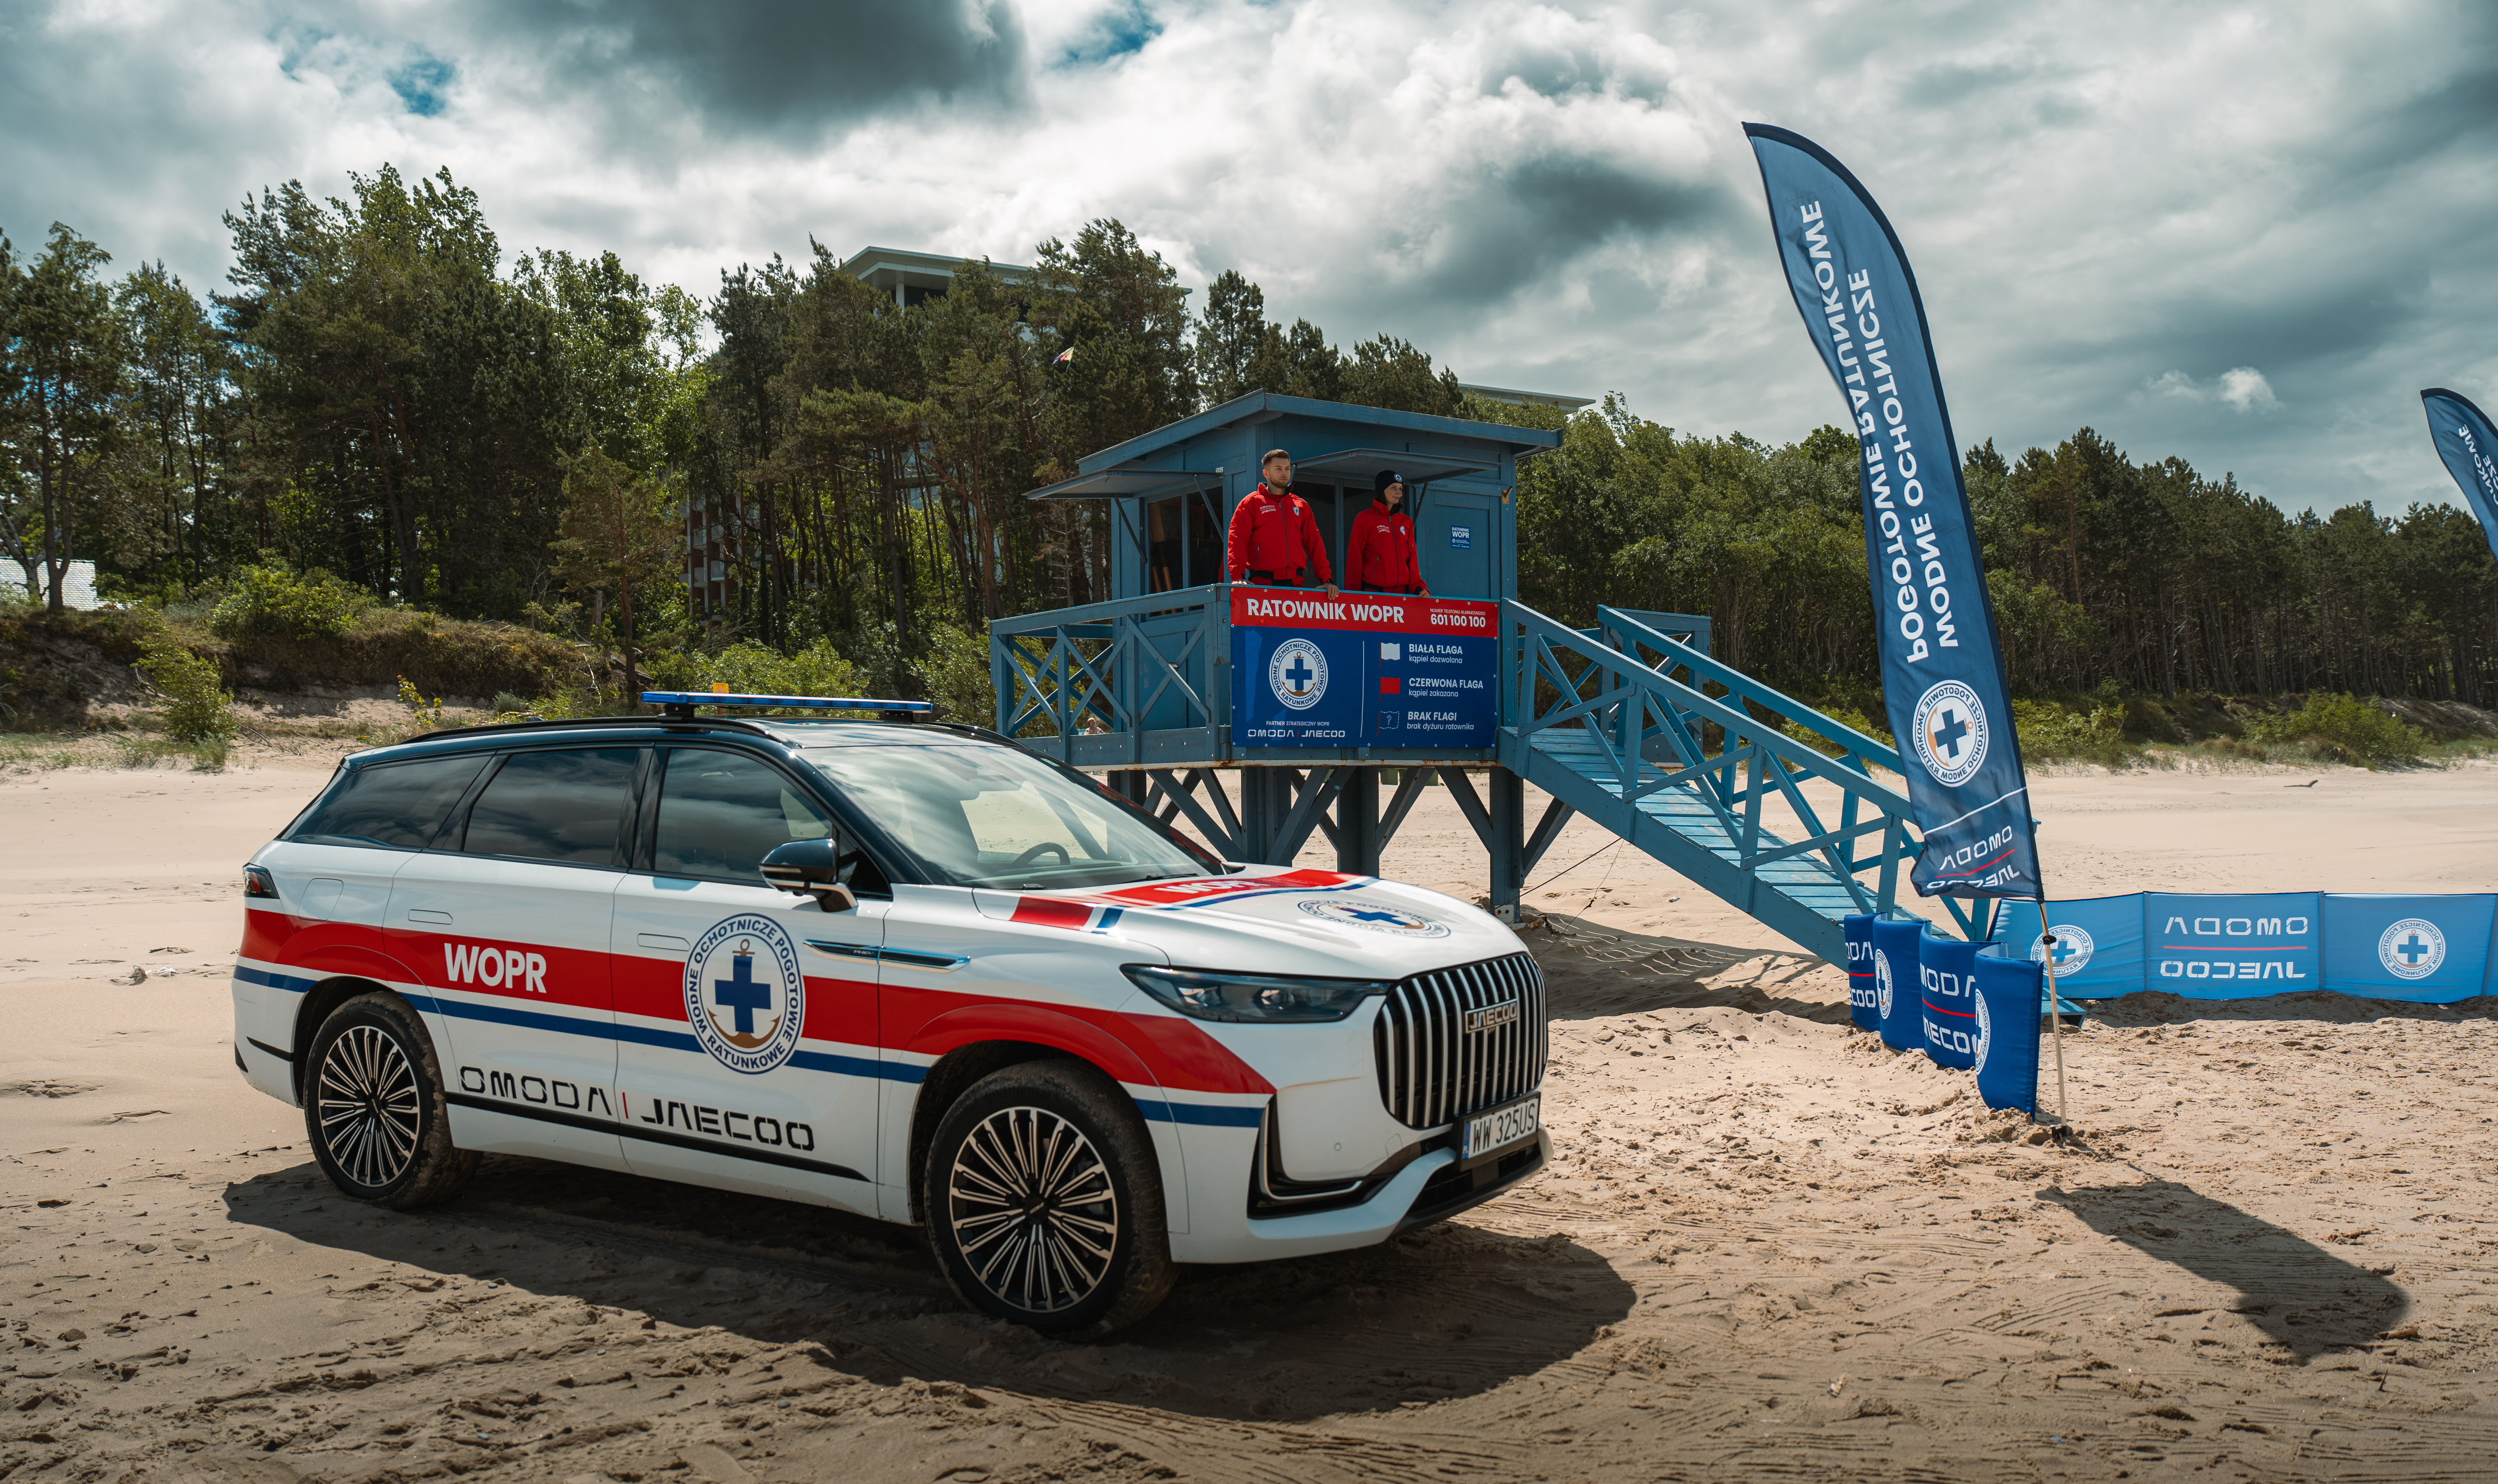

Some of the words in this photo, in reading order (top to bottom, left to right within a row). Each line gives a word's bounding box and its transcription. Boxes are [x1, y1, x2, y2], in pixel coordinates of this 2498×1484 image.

[1247, 598, 1347, 620] RATOWNIK
[1350, 604, 1404, 623] WOPR
[1431, 614, 1448, 625] 601
[1450, 615, 1467, 626] 100
[1469, 616, 1486, 627] 100
[1276, 643, 1312, 663] OCHOTNICZE
[1409, 644, 1434, 653] BIAŁA
[1437, 645, 1463, 654] FLAGA
[1409, 655, 1428, 664] kąpiel
[1273, 664, 1282, 692] WODNE
[1312, 650, 1325, 693] POGOTOWIE
[1409, 678, 1458, 688] CZERWONA
[1460, 679, 1483, 689] FLAGA
[1281, 693, 1317, 705] RATUNKOWE
[1409, 689, 1428, 698] kąpiel
[1408, 712, 1432, 720] BRAK
[1433, 712, 1457, 720] FLAGI
[1423, 723, 1444, 731] dyżuru
[694, 919, 777, 964] OCHOTNICZE
[444, 943, 547, 993] WOPR
[689, 968, 708, 1034] WODNE
[775, 936, 798, 1043] POGOTOWIE
[1469, 1002, 1517, 1029] JAECOO
[707, 1034, 786, 1069] RATUNKOWE
[460, 1066, 612, 1116] OMODA
[640, 1098, 815, 1151] JAECOO
[1473, 1118, 1492, 1153] WW
[1496, 1103, 1535, 1144] 325US
